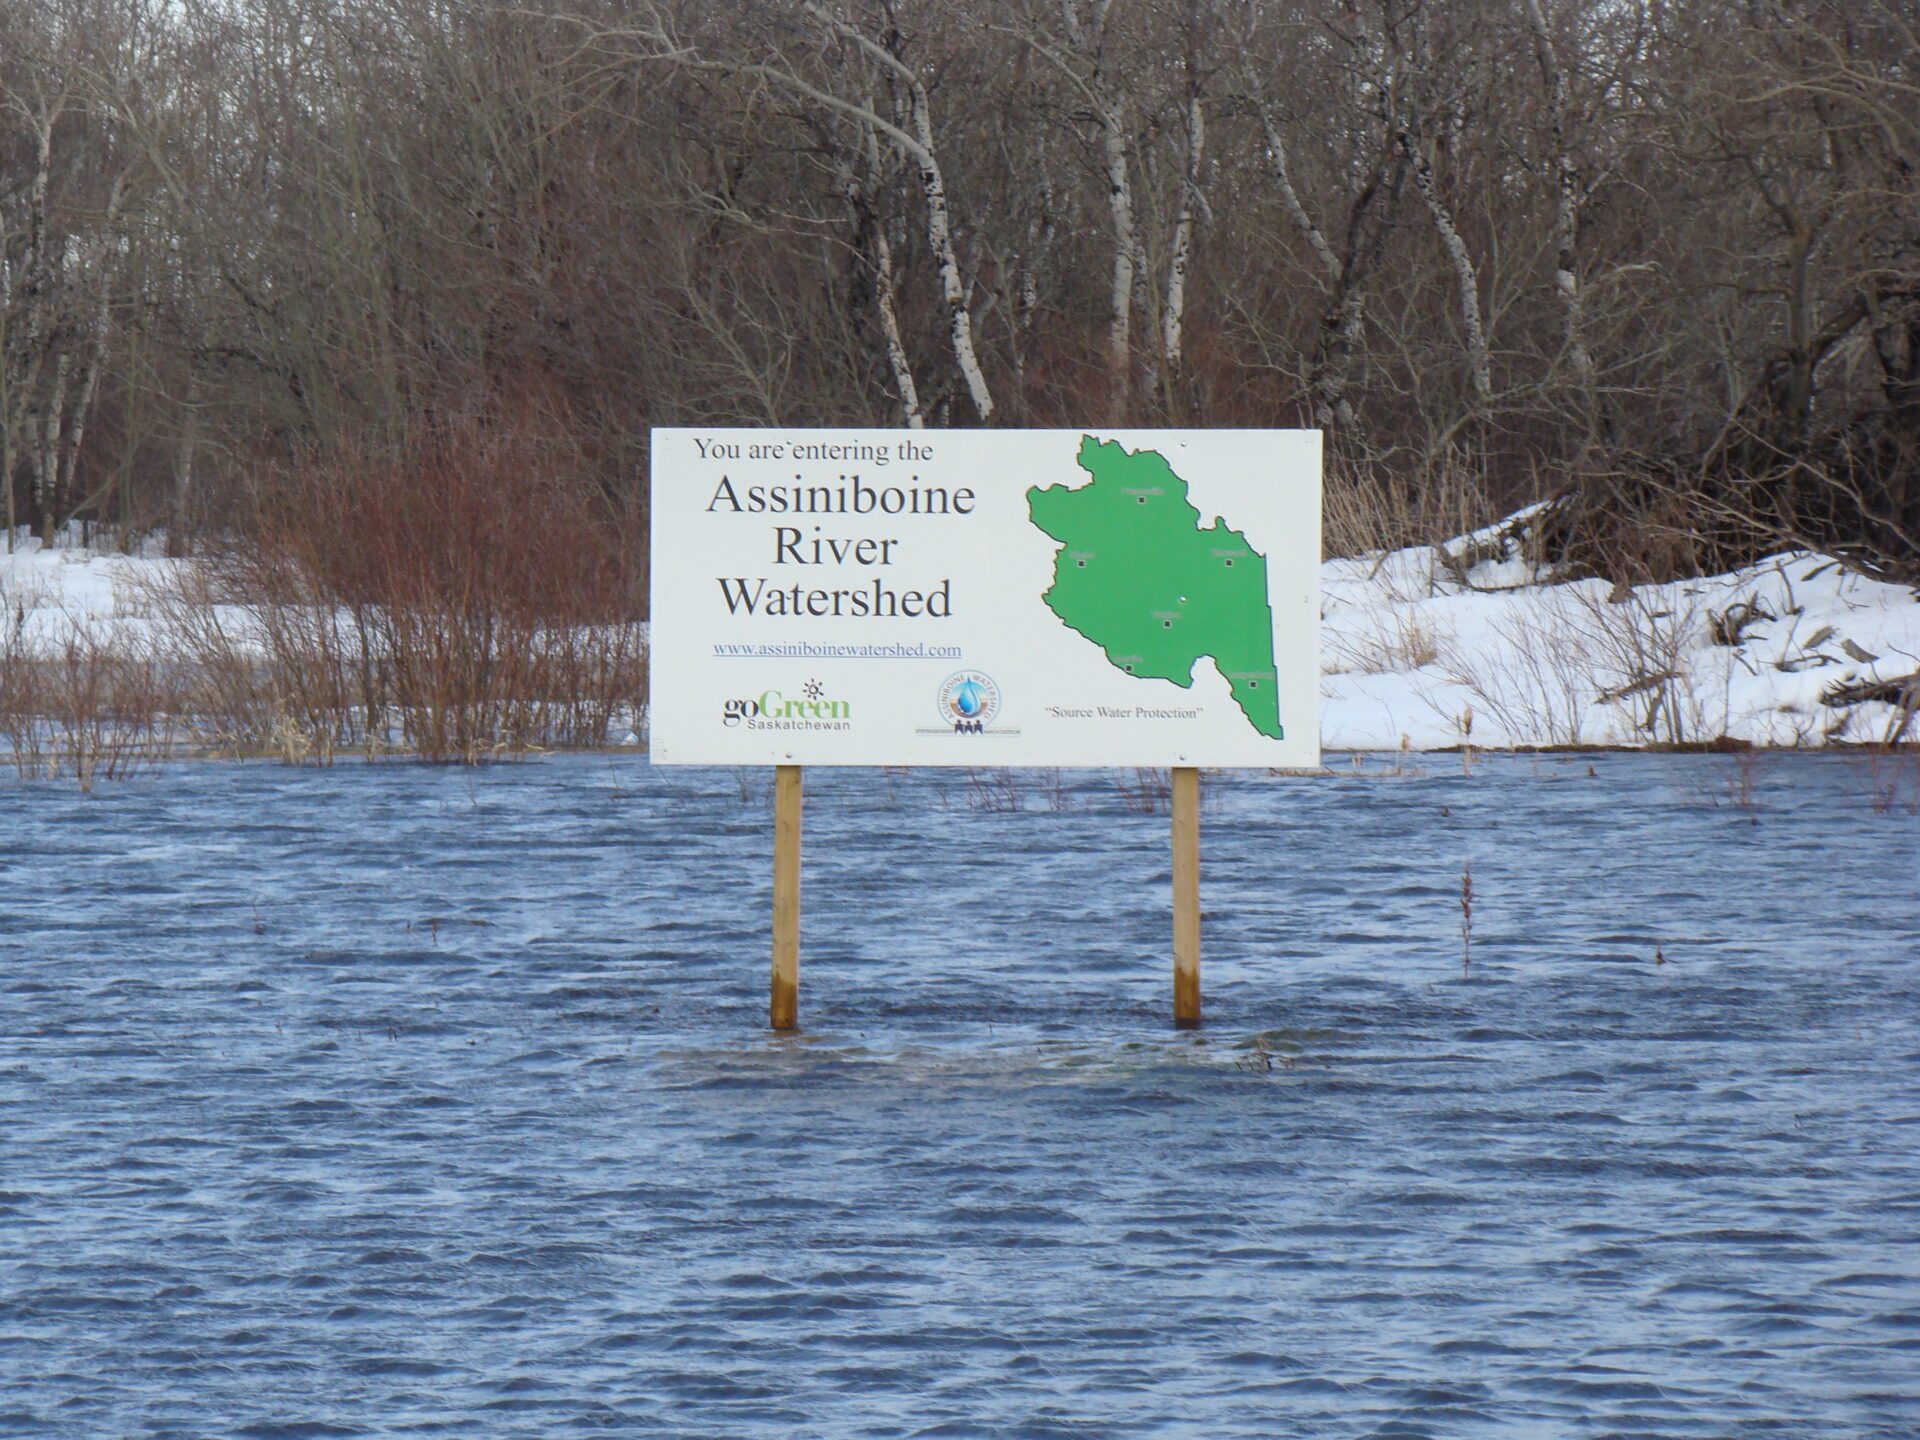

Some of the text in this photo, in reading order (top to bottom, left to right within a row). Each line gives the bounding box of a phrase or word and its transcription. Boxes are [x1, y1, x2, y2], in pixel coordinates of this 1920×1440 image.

[694, 438, 934, 466] You are entering the
[705, 474, 976, 514] Assiniboine
[772, 526, 899, 565] River
[716, 577, 953, 618] Watershed
[713, 641, 962, 658] www.assiniboinewatershed.com
[747, 719, 851, 730] Saskatchewan
[1045, 705, 1204, 719] “Source Water Protection”
